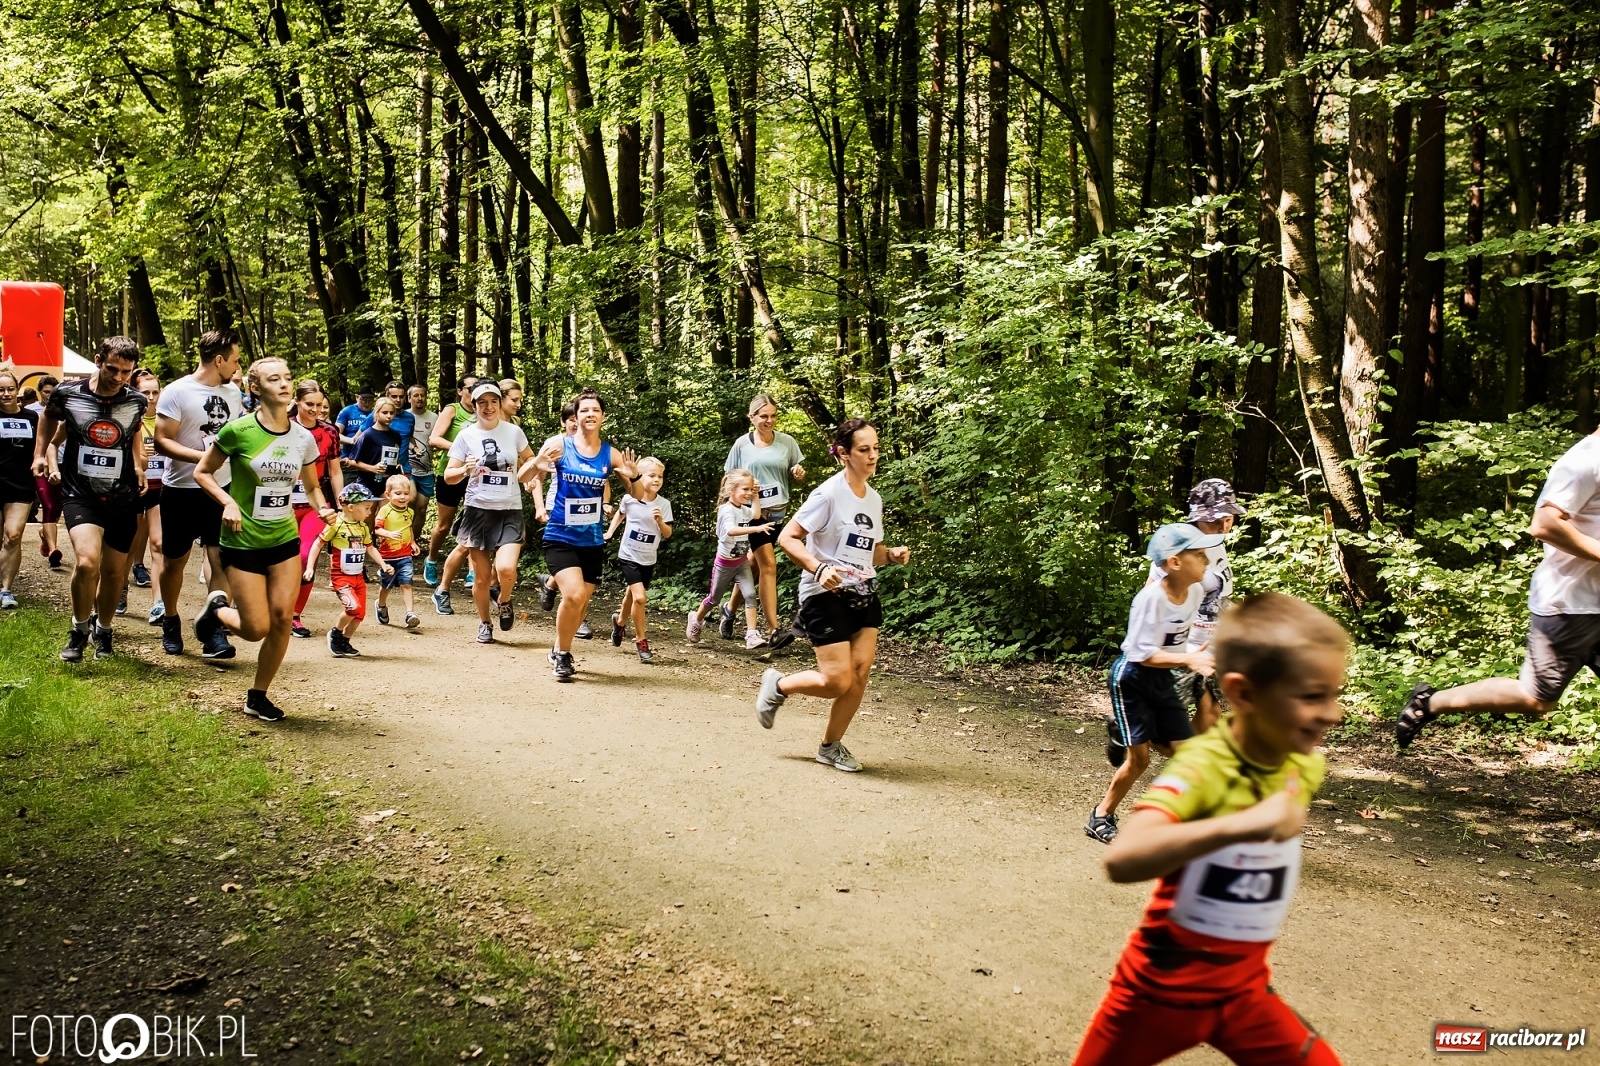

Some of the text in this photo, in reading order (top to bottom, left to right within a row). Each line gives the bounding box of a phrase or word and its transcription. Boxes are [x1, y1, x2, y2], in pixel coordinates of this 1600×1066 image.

[92, 456, 107, 466] 18
[148, 461, 159, 469] 85
[489, 476, 502, 484] 59
[762, 489, 774, 497] 67
[269, 496, 285, 506] 36
[577, 504, 591, 513] 49
[636, 533, 649, 542] 51
[855, 536, 870, 549] 93
[1227, 872, 1273, 900] 40
